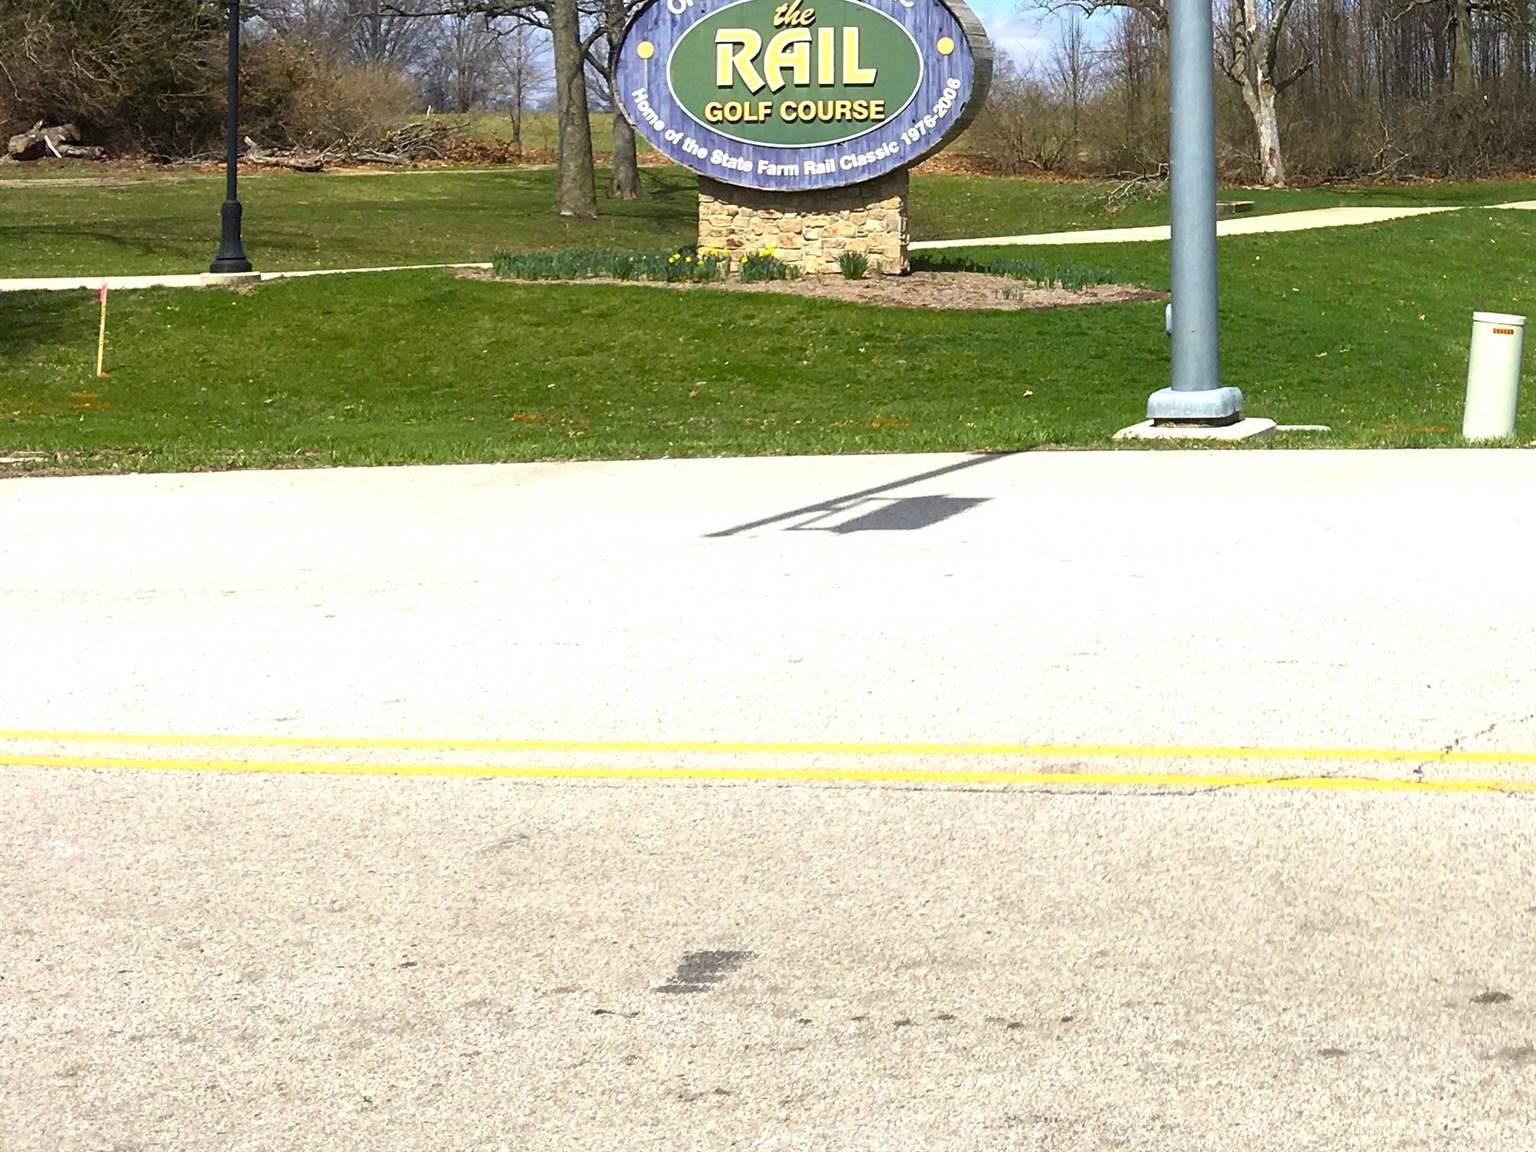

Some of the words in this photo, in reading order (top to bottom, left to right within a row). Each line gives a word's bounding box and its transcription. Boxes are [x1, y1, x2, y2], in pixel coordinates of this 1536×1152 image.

[714, 26, 878, 94] RAIL
[631, 87, 666, 132] Home
[664, 128, 684, 145] of
[681, 136, 708, 160] the
[710, 149, 753, 173] State
[757, 159, 800, 176] Farm
[803, 158, 836, 176] Rail
[839, 140, 900, 171] Classic
[900, 77, 962, 146] 1976-2006
[704, 100, 773, 123] GOLF
[779, 99, 886, 121] COURSE
